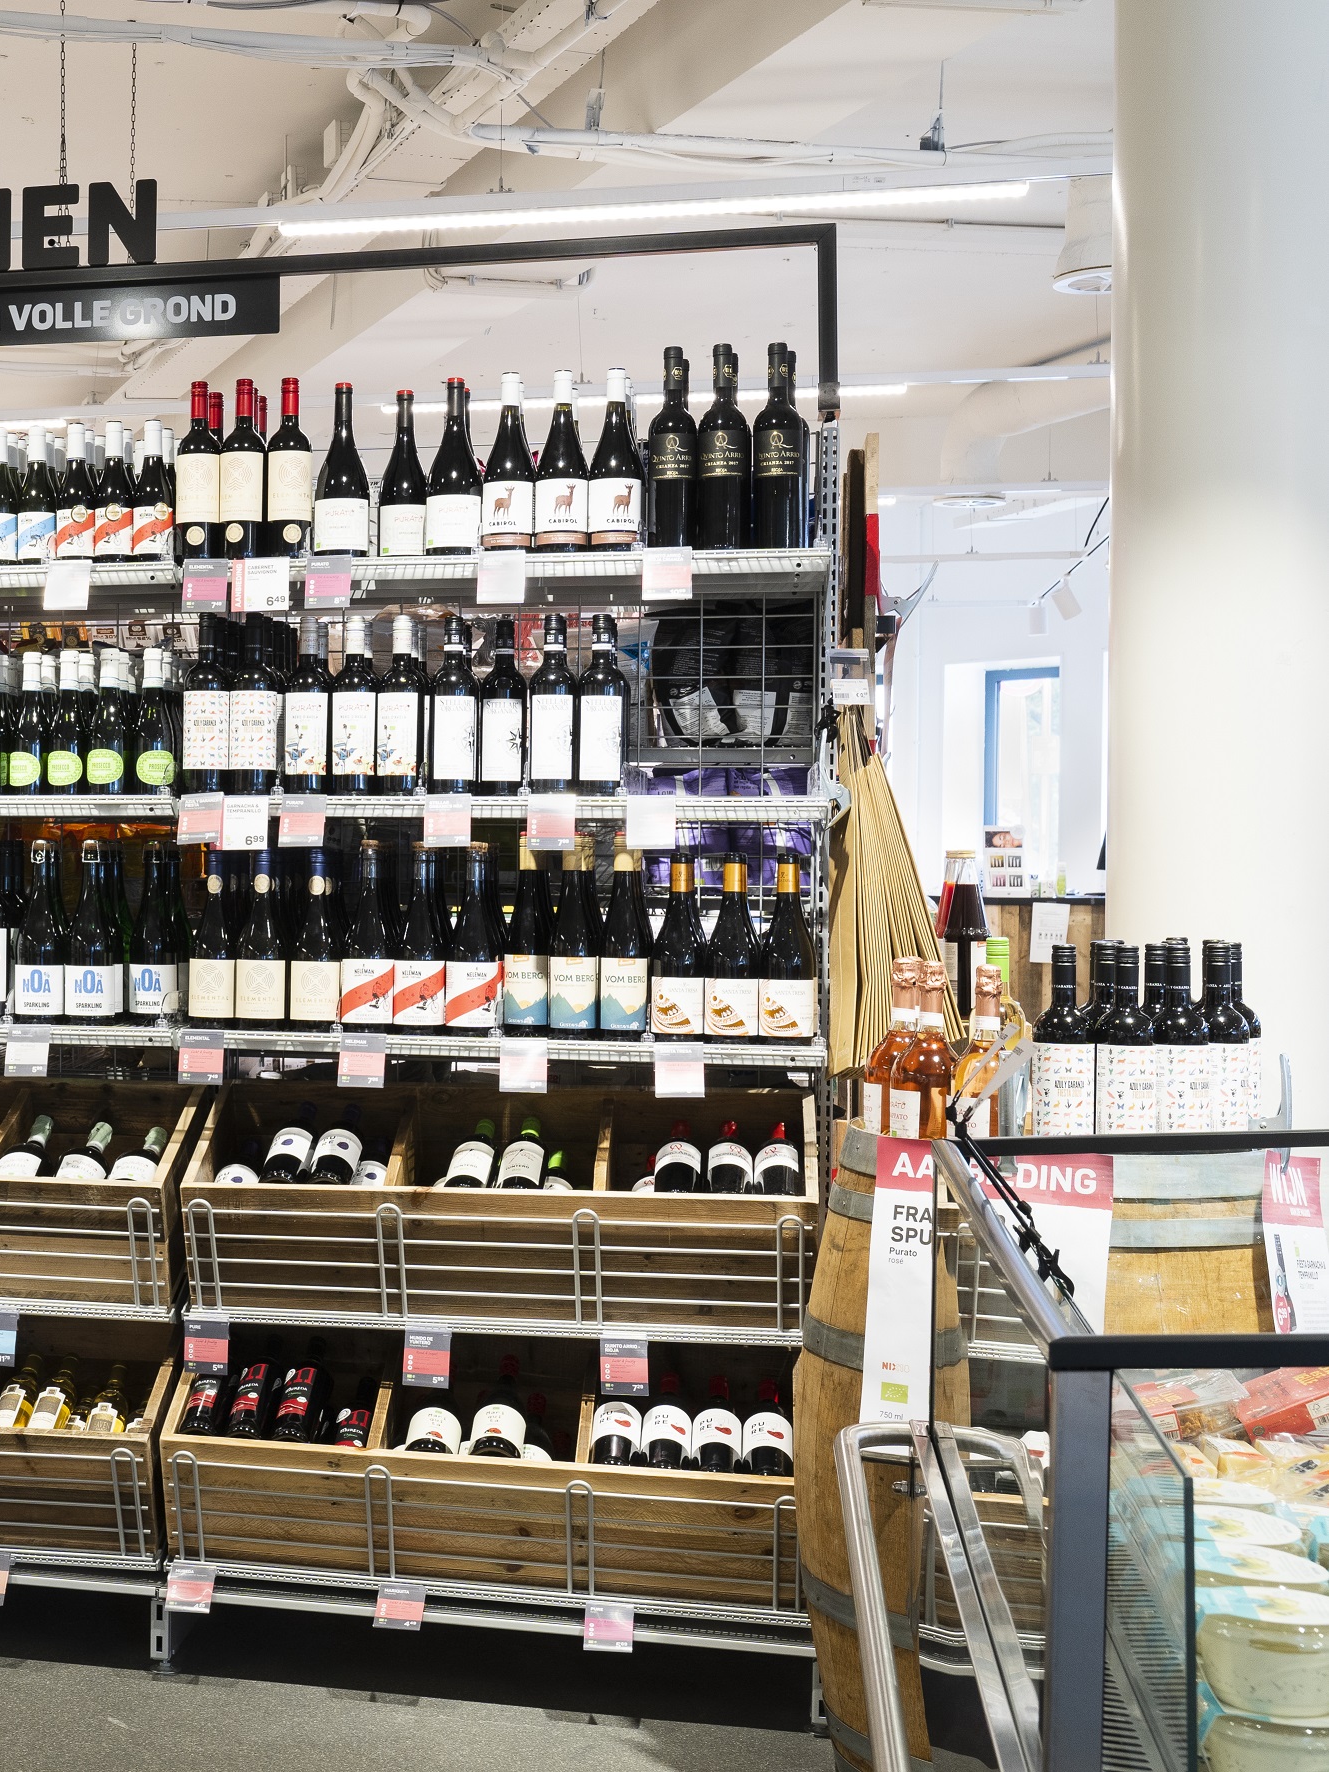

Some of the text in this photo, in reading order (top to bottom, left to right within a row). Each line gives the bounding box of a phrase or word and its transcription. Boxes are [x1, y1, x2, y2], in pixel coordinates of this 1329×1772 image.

[8, 299, 112, 331] VOLLE
[120, 293, 237, 325] GROND
[234, 563, 243, 608] AANBIEDING
[486, 700, 519, 708] STELLAR
[22, 968, 52, 993] NOA
[134, 967, 162, 993] NOA
[521, 971, 544, 980] BERG
[553, 974, 595, 982] VOM BERG
[605, 975, 645, 983] VOM BERG
[74, 969, 103, 994] NOA
[1055, 1079, 1065, 1089] AZUL
[1068, 1079, 1085, 1089] GARANZA
[1269, 1162, 1308, 1207] WIJN
[889, 1246, 918, 1257] Purato
[888, 1257, 904, 1265] rosé
[879, 1410, 893, 1419] 750
